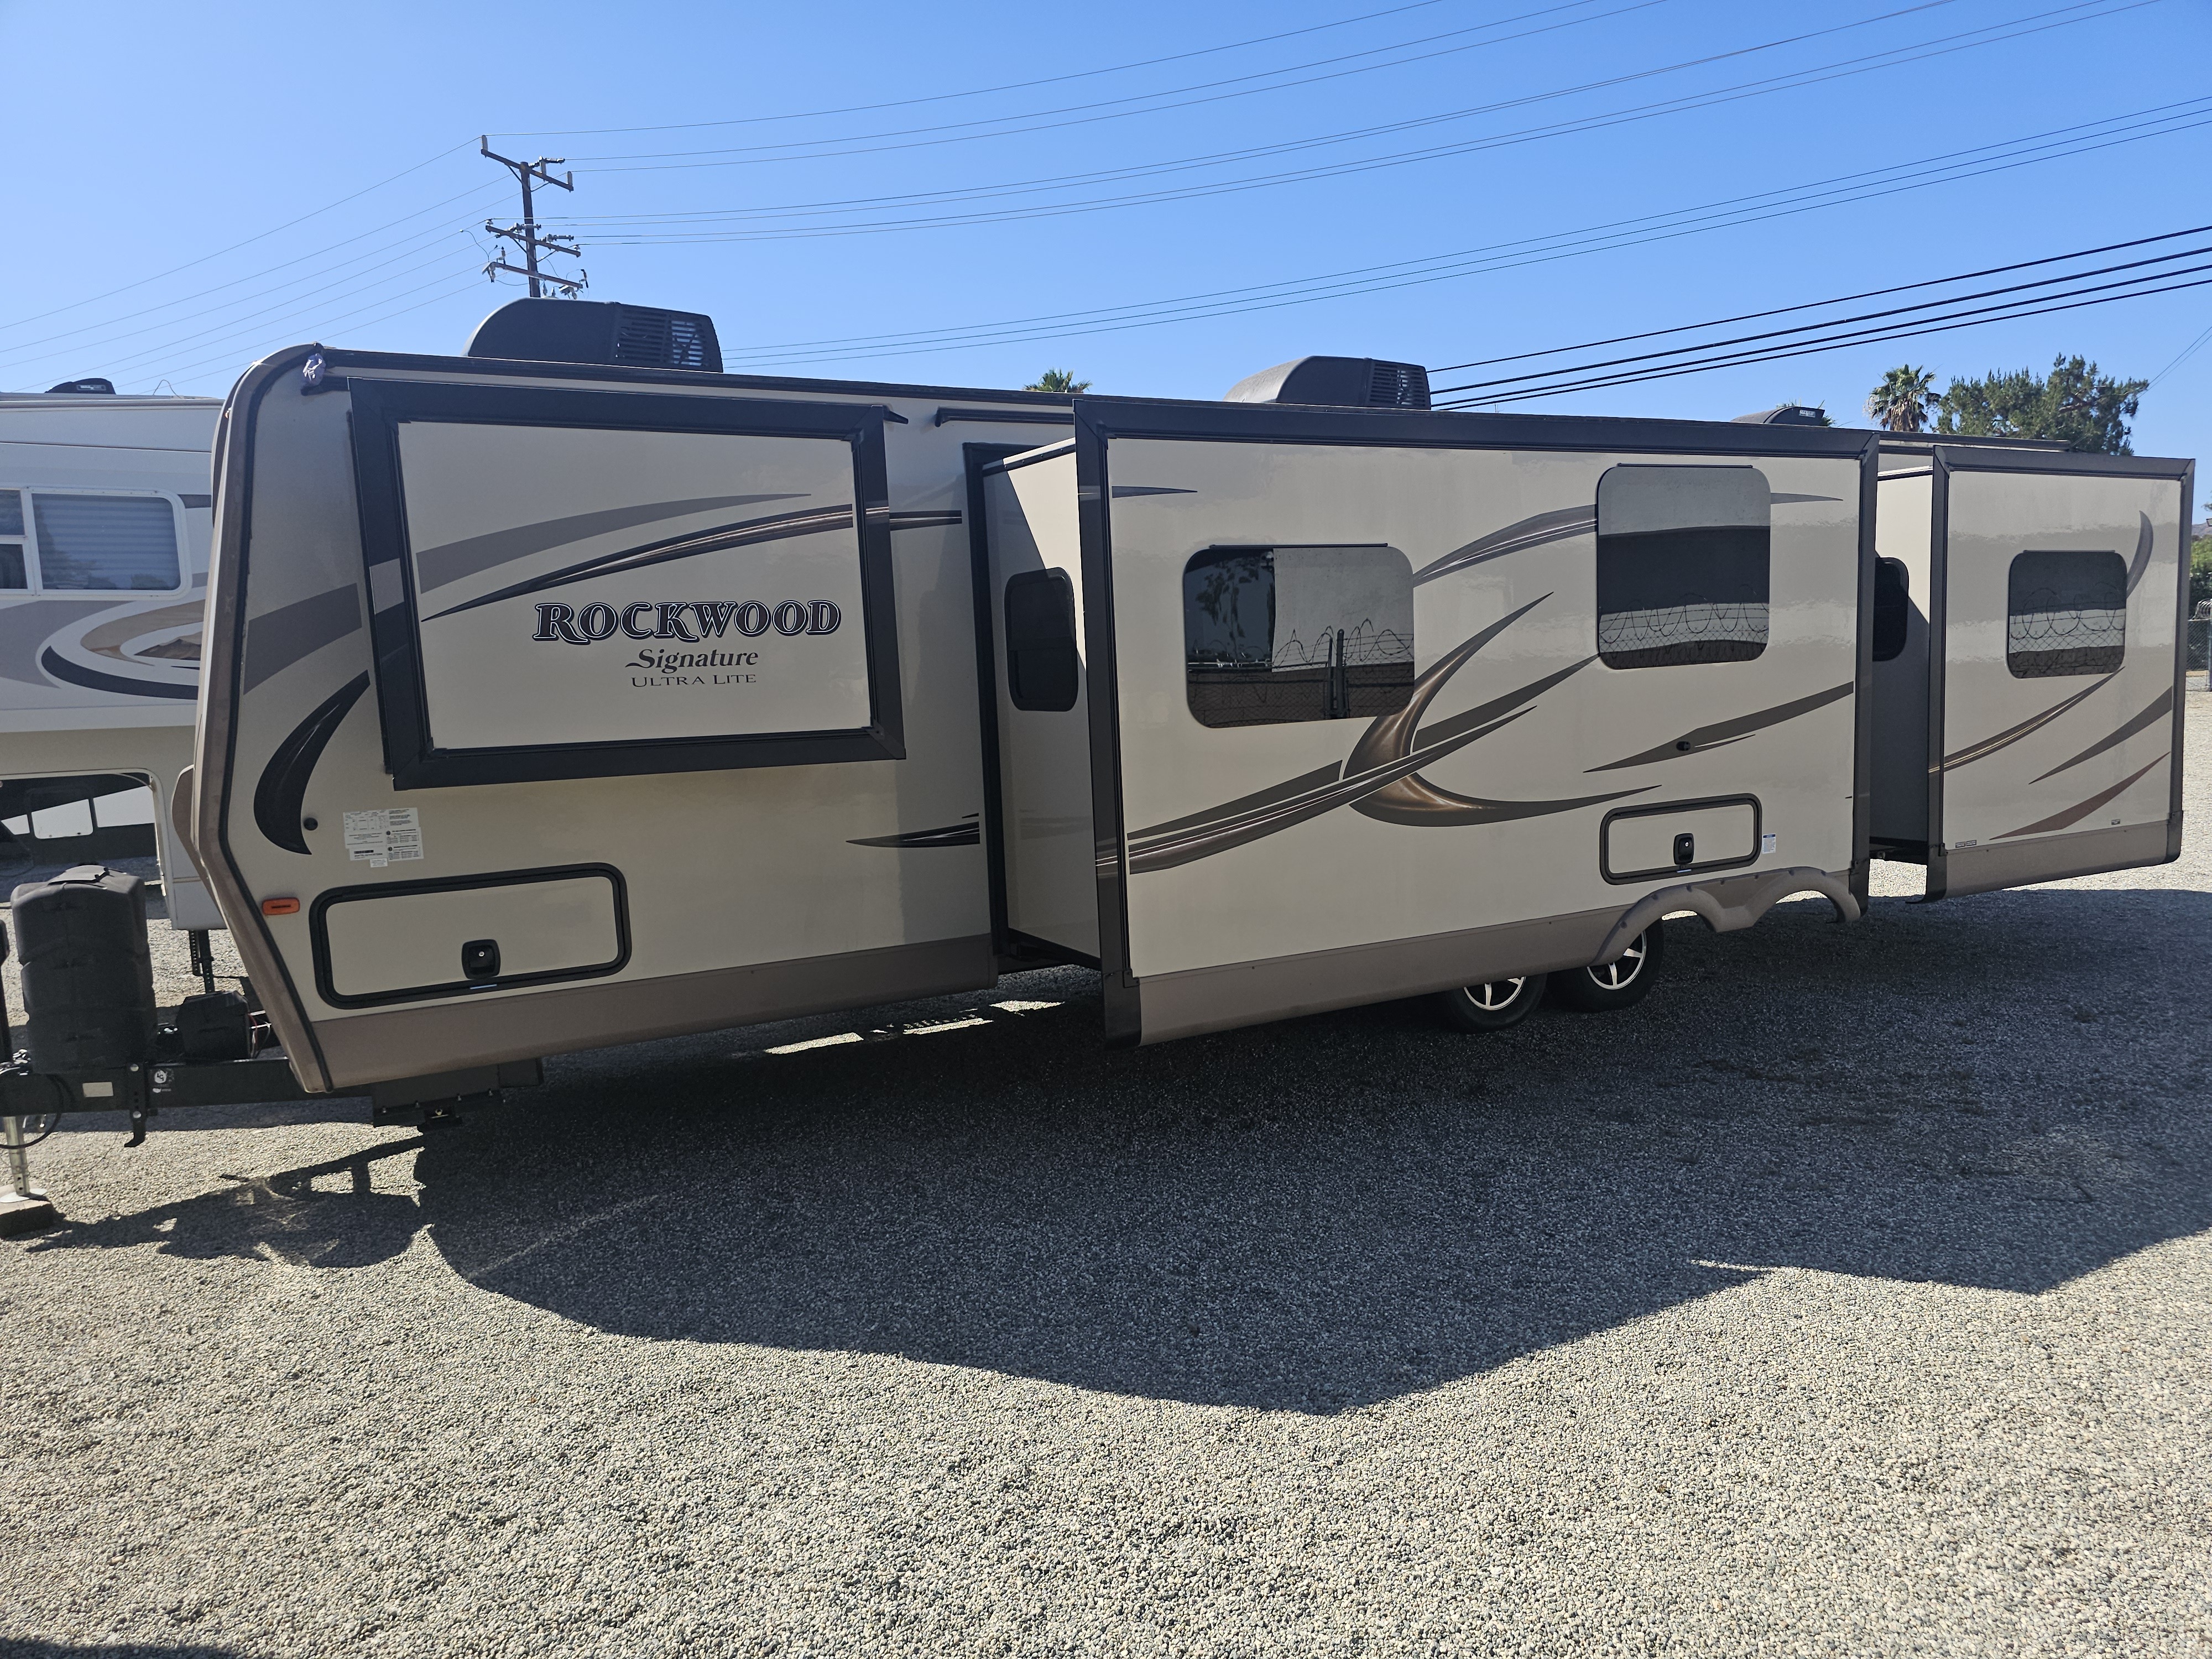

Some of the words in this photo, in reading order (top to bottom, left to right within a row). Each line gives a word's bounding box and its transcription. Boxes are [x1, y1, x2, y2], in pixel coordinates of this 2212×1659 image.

[533, 599, 842, 644] ROCKWOOD
[625, 649, 758, 674] Signature
[632, 676, 705, 687] ULTRA
[713, 674, 757, 685] LITE
